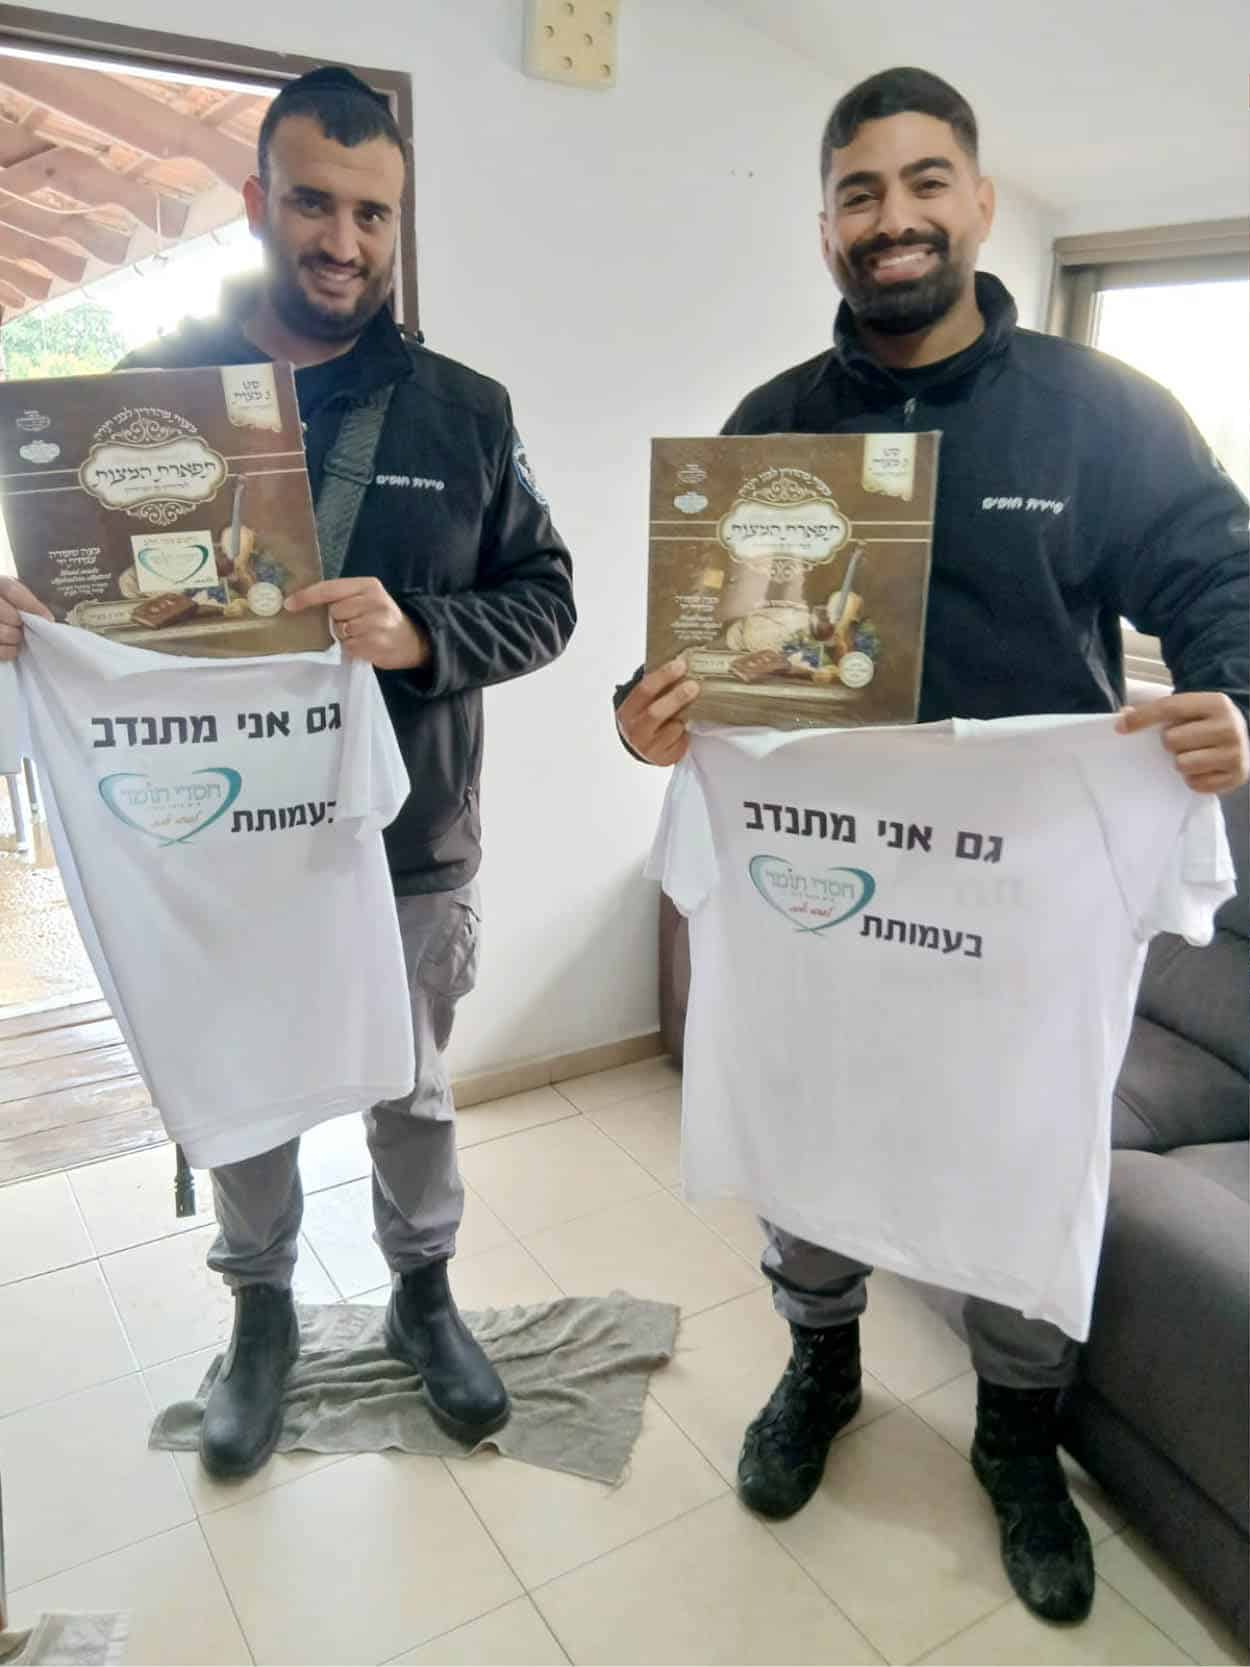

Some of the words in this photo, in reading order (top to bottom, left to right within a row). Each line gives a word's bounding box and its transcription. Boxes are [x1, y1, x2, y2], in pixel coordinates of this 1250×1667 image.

[91, 715, 218, 747] מתנדב
[237, 710, 290, 738] אני
[306, 702, 341, 733] גם
[743, 801, 856, 843] מתנדב
[877, 819, 933, 853] אני
[956, 831, 1004, 863] גם
[860, 914, 983, 958] בעמותת
